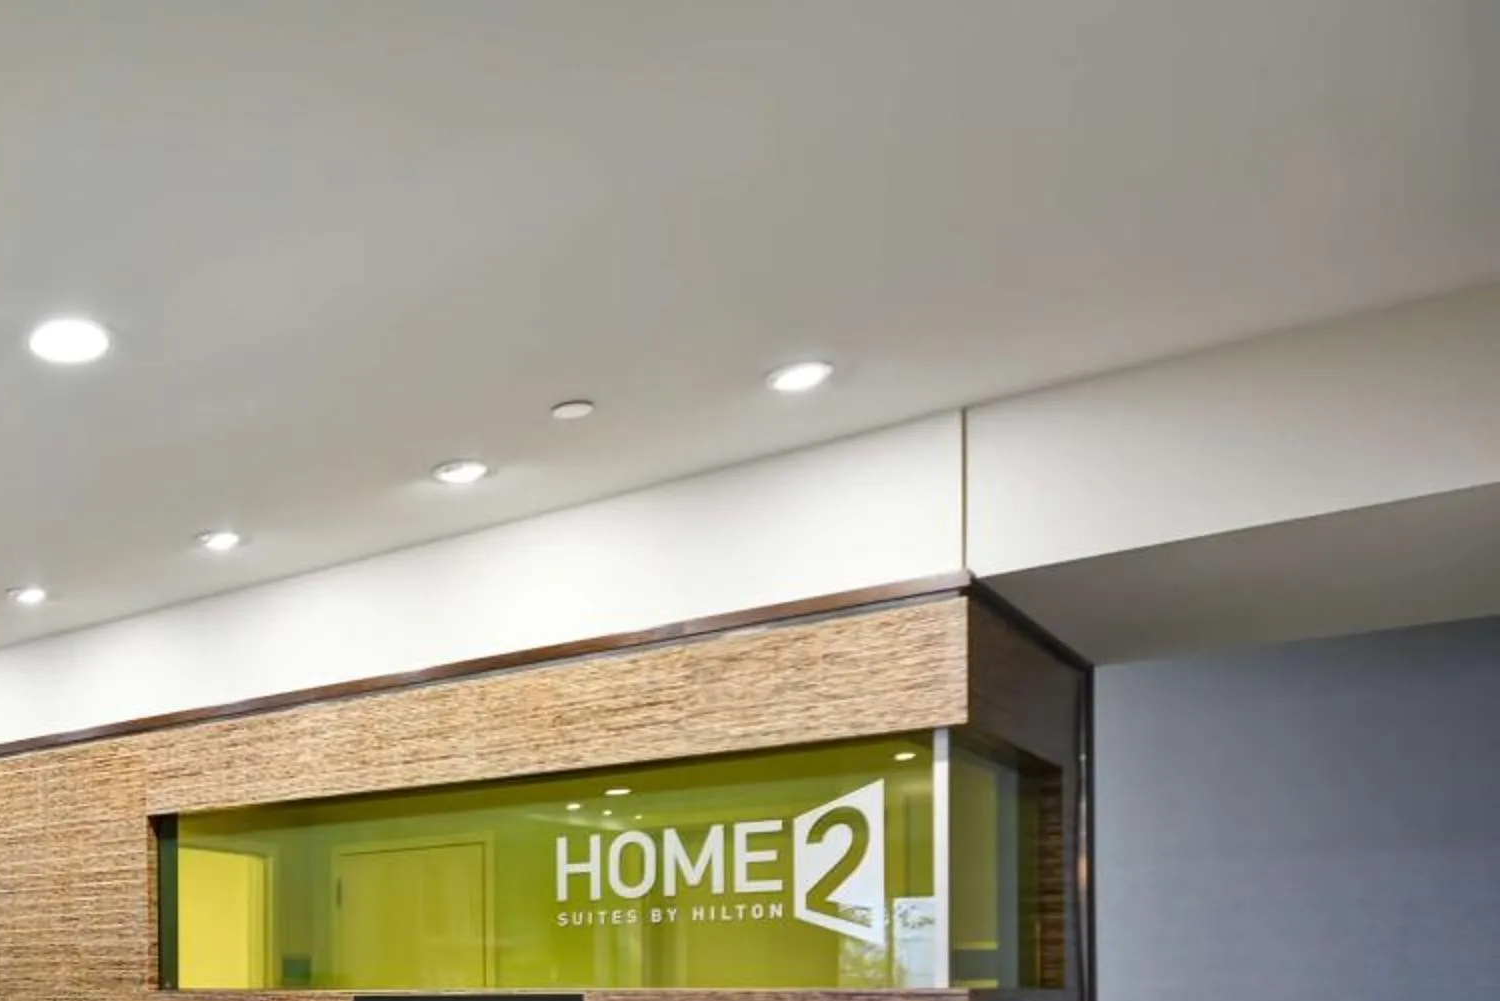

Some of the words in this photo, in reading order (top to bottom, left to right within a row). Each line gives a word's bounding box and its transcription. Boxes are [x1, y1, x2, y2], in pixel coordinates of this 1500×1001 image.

[557, 909, 639, 926] SUITES
[651, 908, 677, 923] BY
[691, 903, 783, 920] HILTON
